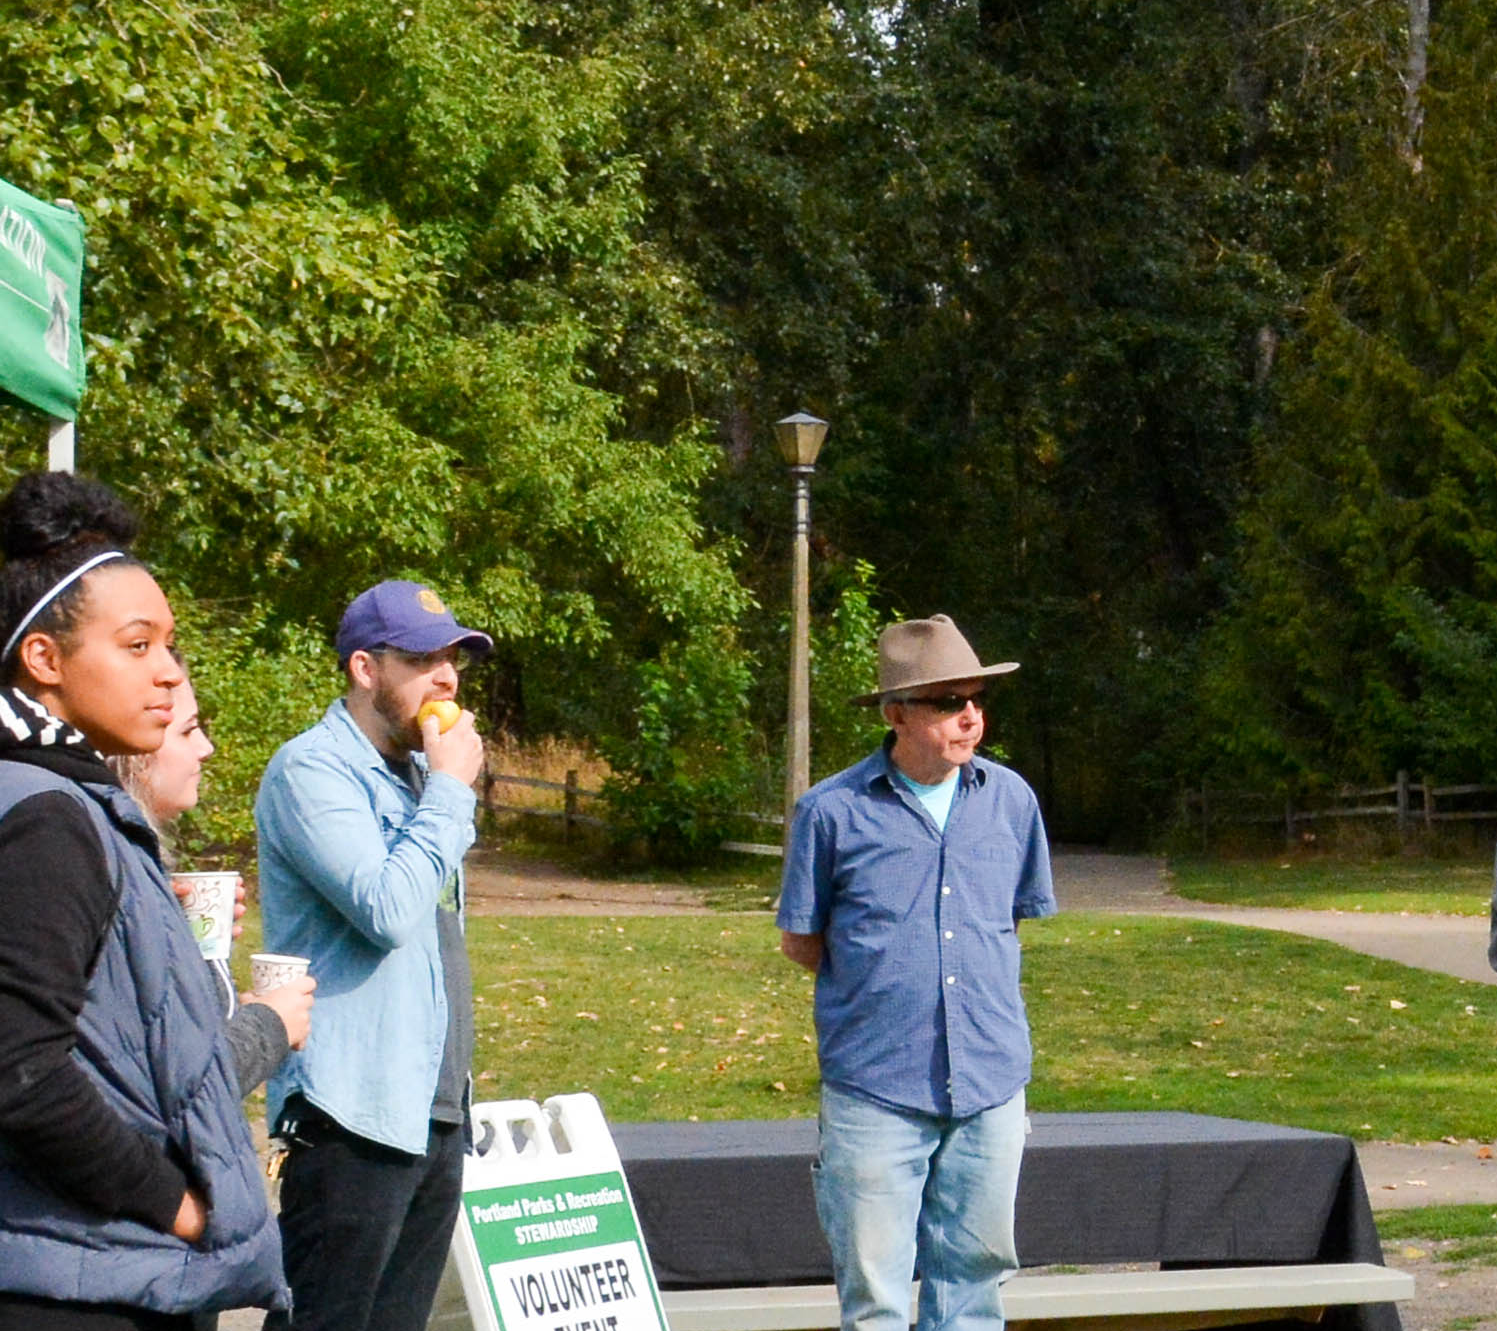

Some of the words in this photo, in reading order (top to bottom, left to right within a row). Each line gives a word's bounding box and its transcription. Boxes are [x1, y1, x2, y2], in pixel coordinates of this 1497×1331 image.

[471, 1199, 522, 1224] Portland
[521, 1195, 555, 1217] Parks
[554, 1193, 567, 1212] &
[565, 1186, 624, 1211] Recreation
[514, 1214, 599, 1245] STEWARDSHIP
[510, 1258, 636, 1319] VOLUNTEER
